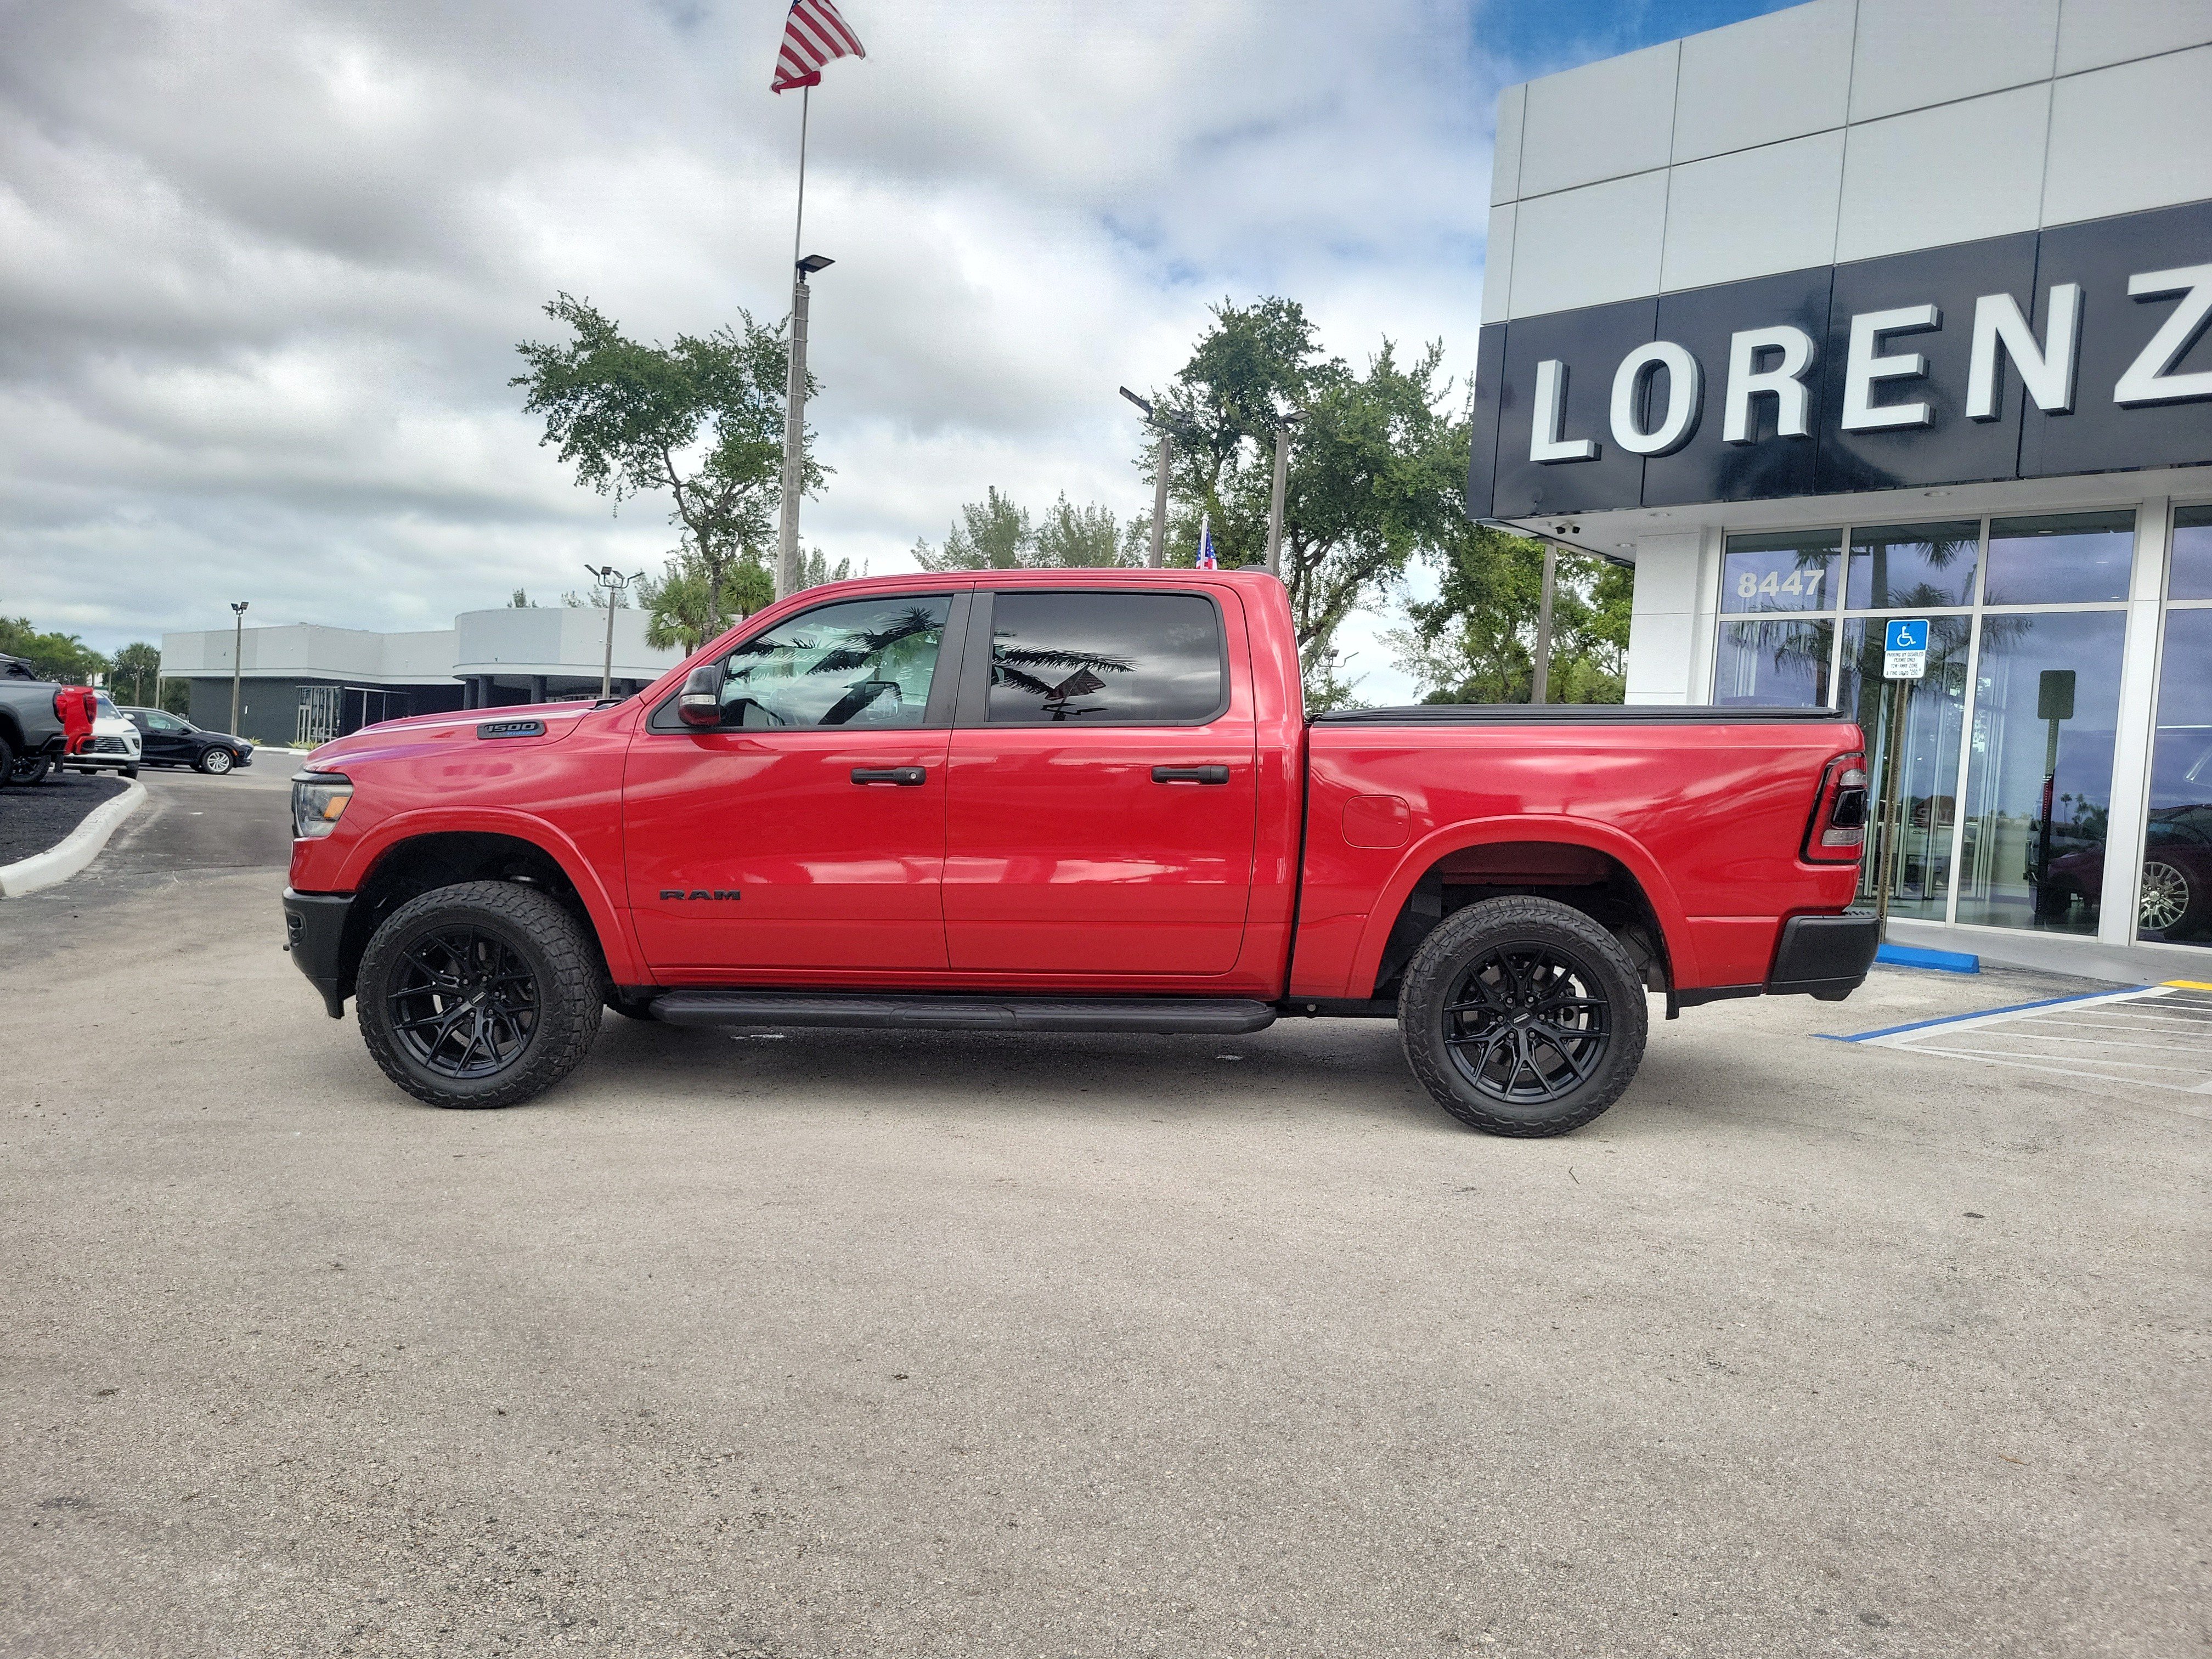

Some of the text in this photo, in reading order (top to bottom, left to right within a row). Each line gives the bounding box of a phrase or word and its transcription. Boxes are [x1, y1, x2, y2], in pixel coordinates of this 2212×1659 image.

[1529, 263, 2212, 464] LORENZ
[1737, 569, 1825, 598] 8447
[487, 723, 536, 732] 1500
[659, 889, 741, 900] RAM
